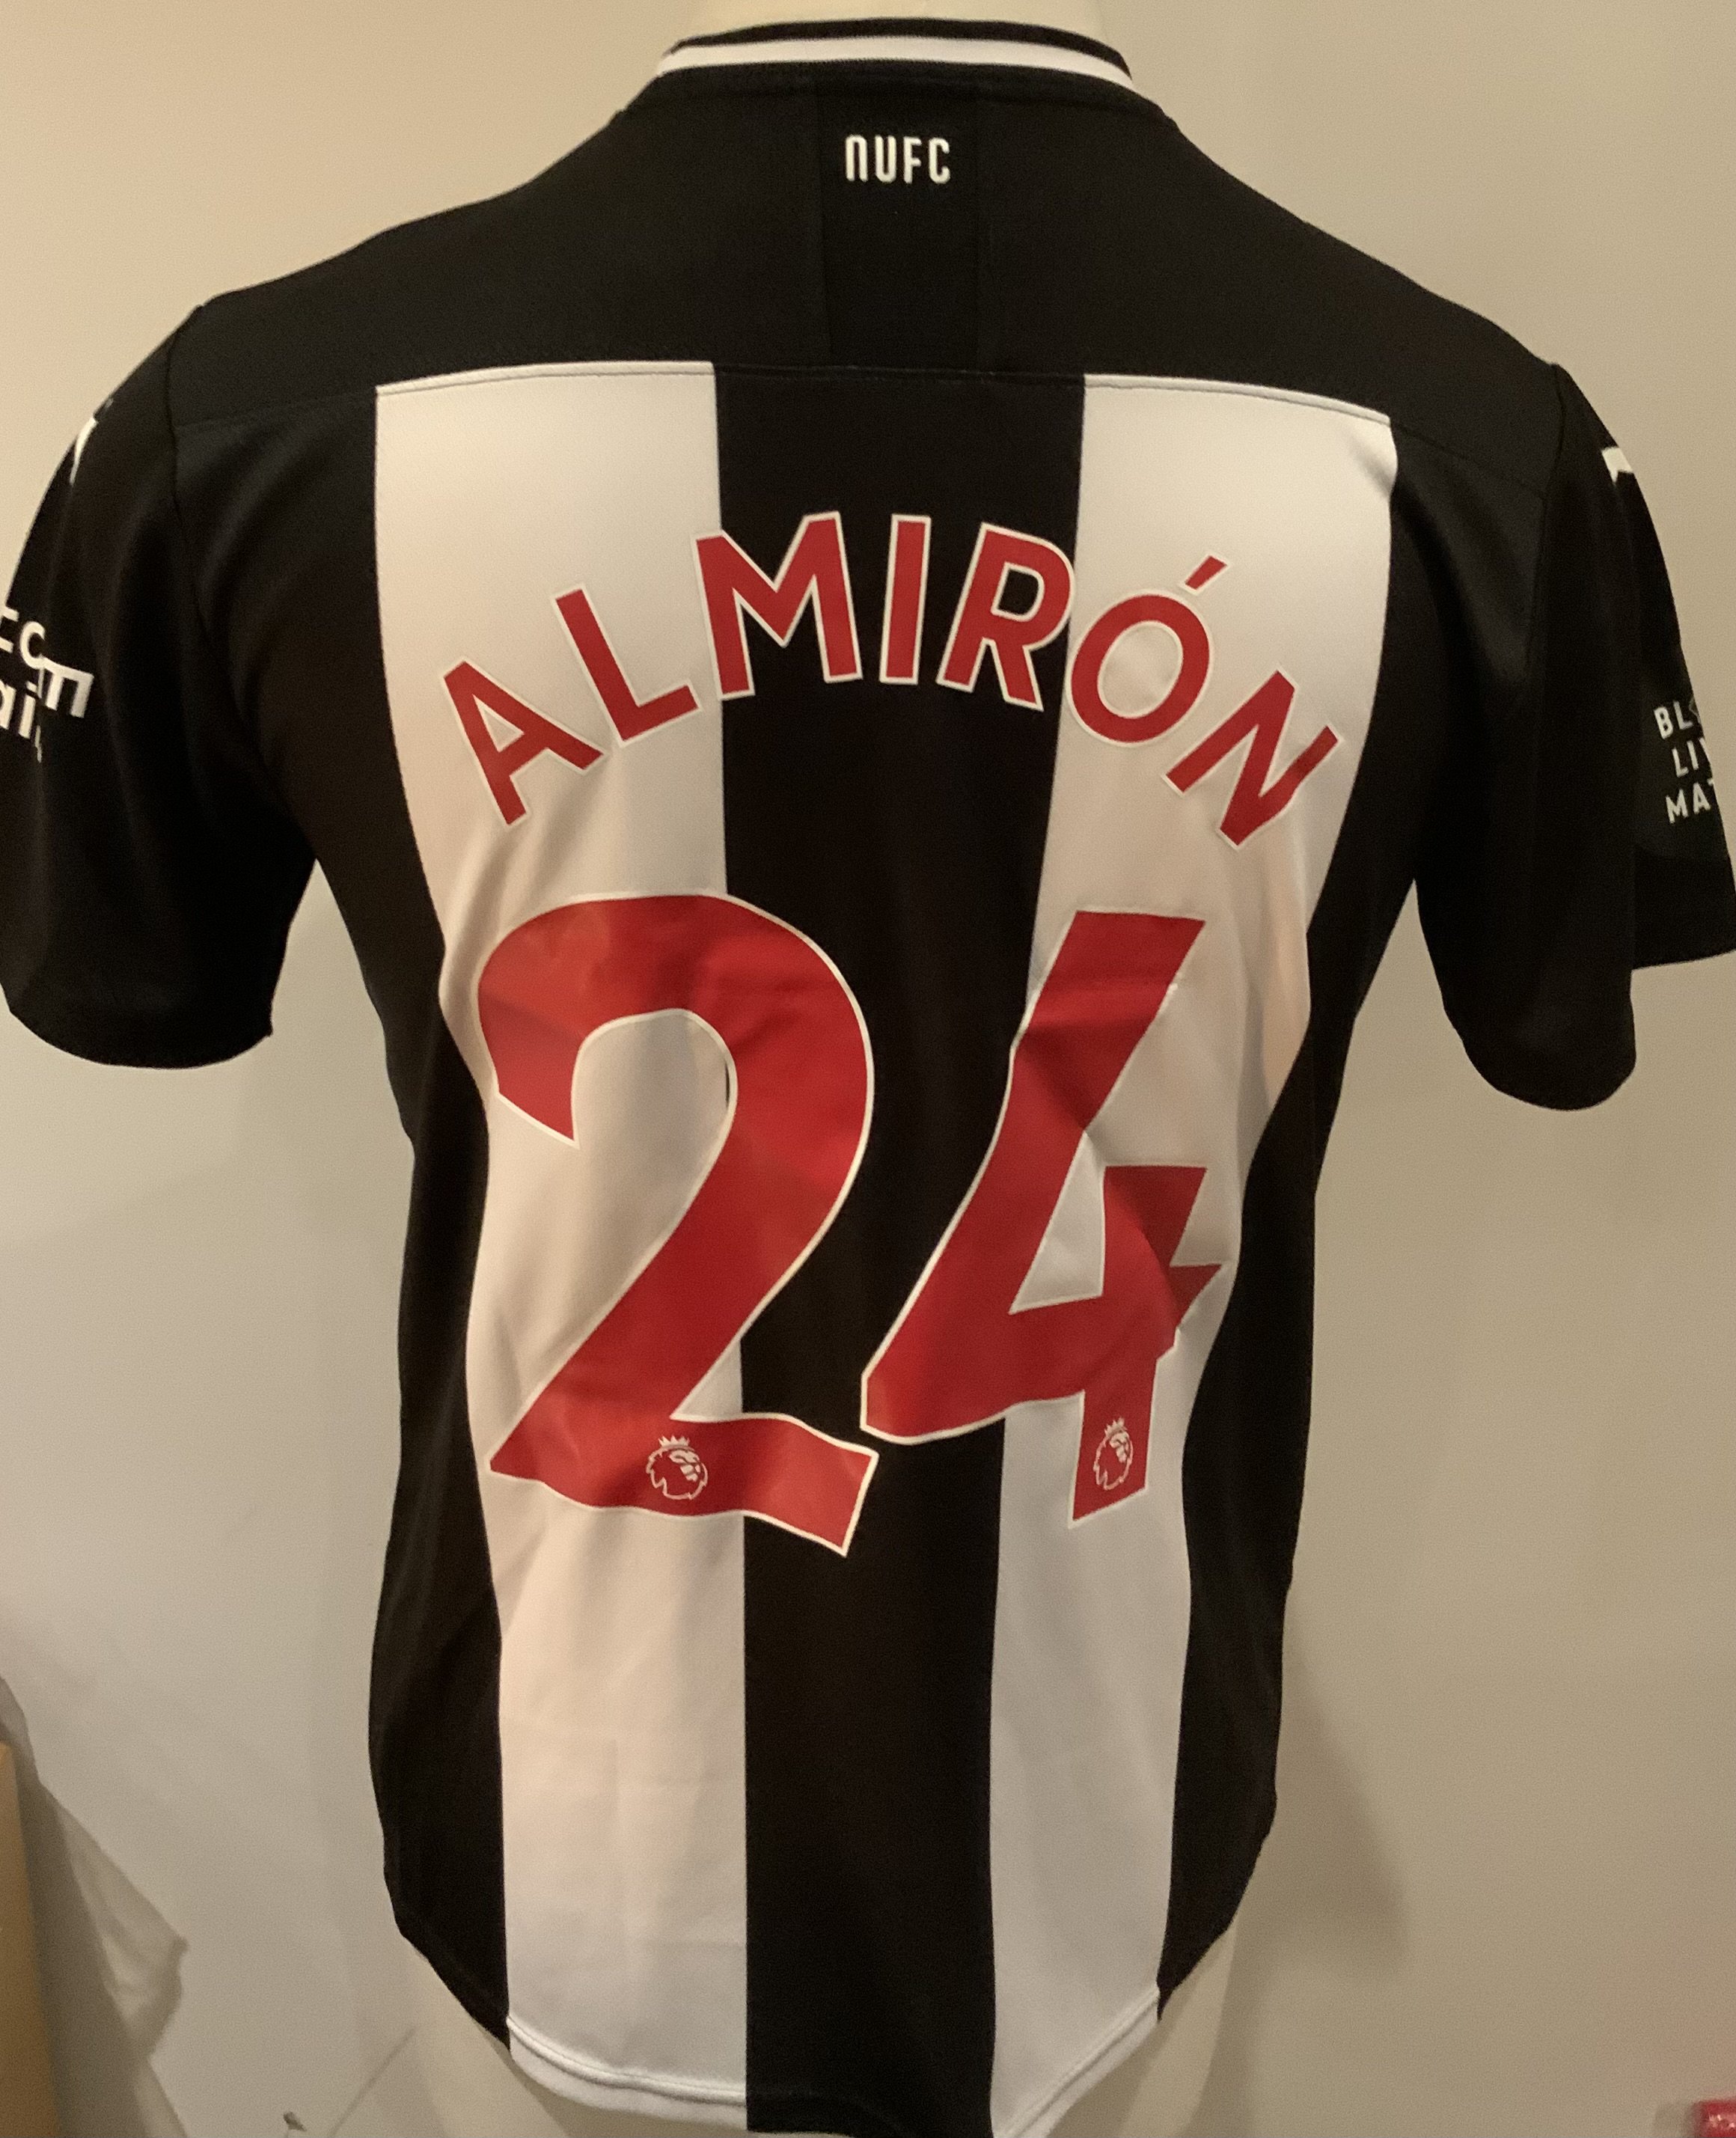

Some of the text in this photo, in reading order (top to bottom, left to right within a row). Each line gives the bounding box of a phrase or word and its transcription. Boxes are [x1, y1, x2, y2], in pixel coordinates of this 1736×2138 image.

[845, 134, 951, 184] NUFC
[441, 510, 1341, 847] ALMIRÓN
[475, 891, 1232, 1558] 24
